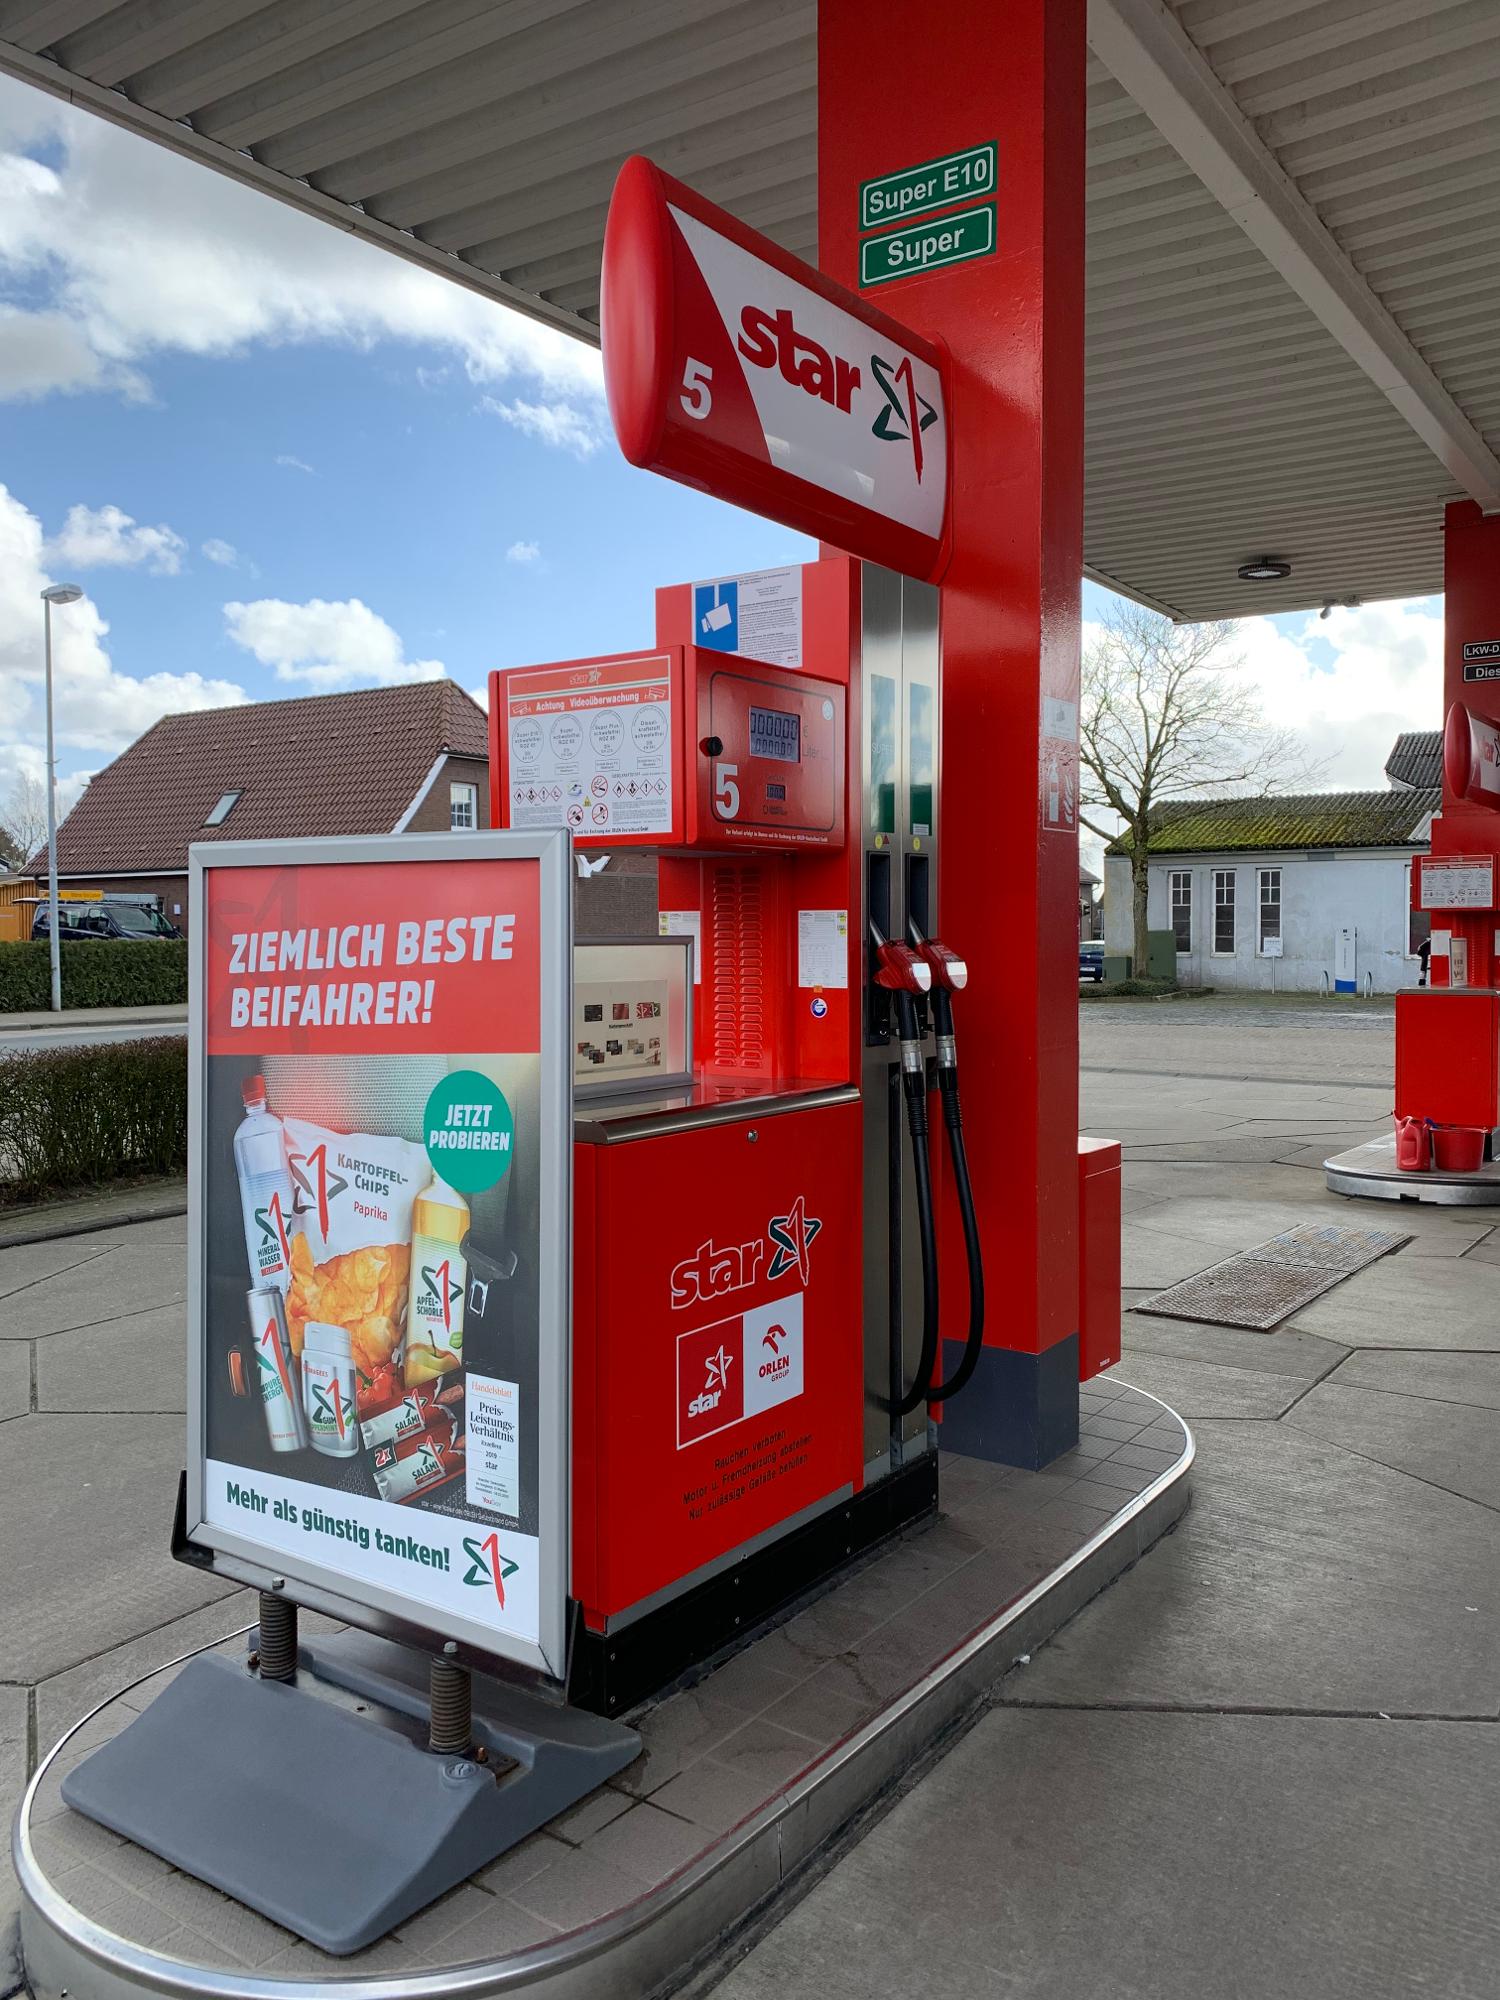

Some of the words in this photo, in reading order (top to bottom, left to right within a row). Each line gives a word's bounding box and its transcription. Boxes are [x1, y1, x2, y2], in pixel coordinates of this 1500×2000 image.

[869, 176, 936, 215] Super
[943, 158, 987, 192] E10
[887, 225, 965, 267] Super
[737, 305, 861, 414] star
[680, 356, 713, 420] 5
[536, 700, 565, 711] Achtung
[569, 692, 640, 708] Videoüberwachung
[715, 762, 740, 819] 5
[229, 923, 385, 974] ZIEMLICH
[395, 914, 516, 966] BESTE
[230, 979, 436, 1028] BEIFAHRER!
[444, 1104, 493, 1127] JETZT
[429, 1130, 510, 1151] PROBIEREN
[337, 1152, 409, 1185] KARTOFFEL-
[354, 1174, 390, 1196] CHIPS
[353, 1200, 388, 1221] Paprika
[257, 1242, 281, 1258] MINERAL
[258, 1252, 281, 1268] WASSER
[671, 1238, 764, 1310] star
[416, 1295, 438, 1307] APFEL-
[416, 1305, 444, 1318] SCHORLE
[758, 1355, 790, 1378] ORLEN
[771, 1368, 790, 1382] GROUP
[471, 1381, 513, 1398] Handelsblatt
[479, 1401, 504, 1417] Preis-
[687, 1389, 722, 1418] star
[395, 1414, 420, 1432] SALAMI
[470, 1410, 516, 1432] Leistungs-
[469, 1422, 515, 1443] Verhältnis
[714, 1447, 749, 1470] Rauchen
[752, 1430, 786, 1452] verboten
[412, 1460, 439, 1480] SALAMI
[485, 1460, 499, 1470] star
[683, 1486, 709, 1505] Motor
[722, 1451, 777, 1484] Fremdheizung
[689, 1507, 703, 1521] Nur
[707, 1484, 746, 1512] zulässige
[226, 1480, 269, 1514] Mehr
[273, 1498, 298, 1524] als
[302, 1507, 370, 1550] günstig
[375, 1527, 450, 1572] tanken!
